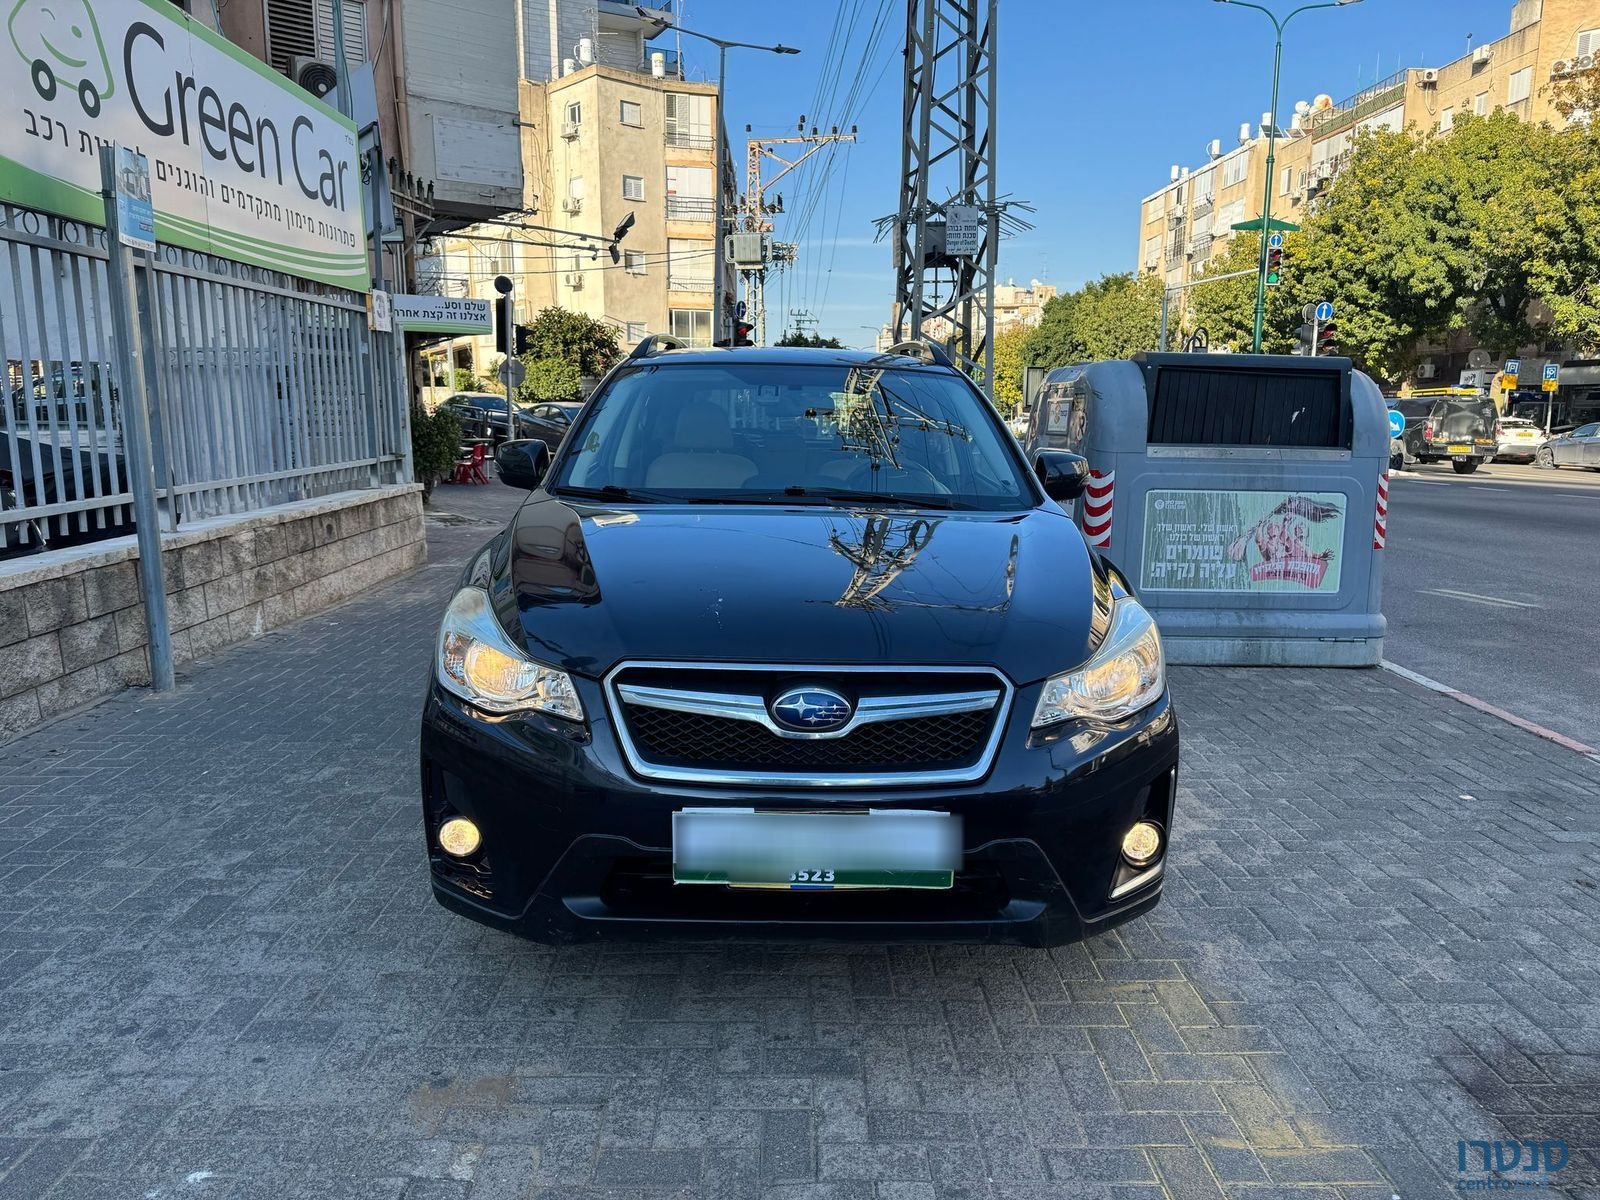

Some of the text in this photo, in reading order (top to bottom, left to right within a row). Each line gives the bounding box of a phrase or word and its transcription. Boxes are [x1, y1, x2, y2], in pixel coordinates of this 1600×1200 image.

[123, 21, 348, 212] Green Car
[24, 108, 69, 147] רכב
[156, 159, 215, 198] והוגנים
[221, 184, 281, 222] מתקדמים
[286, 208, 315, 234] מימון
[318, 220, 355, 248] פתרונות
[422, 310, 443, 321] קצת
[446, 311, 457, 319] זה
[460, 311, 486, 321] אצלנו
[464, 301, 486, 311] שלם
[1189, 533, 1200, 541] של
[1166, 544, 1224, 561] שומרים
[1151, 560, 1237, 580] עליה נקייה!
